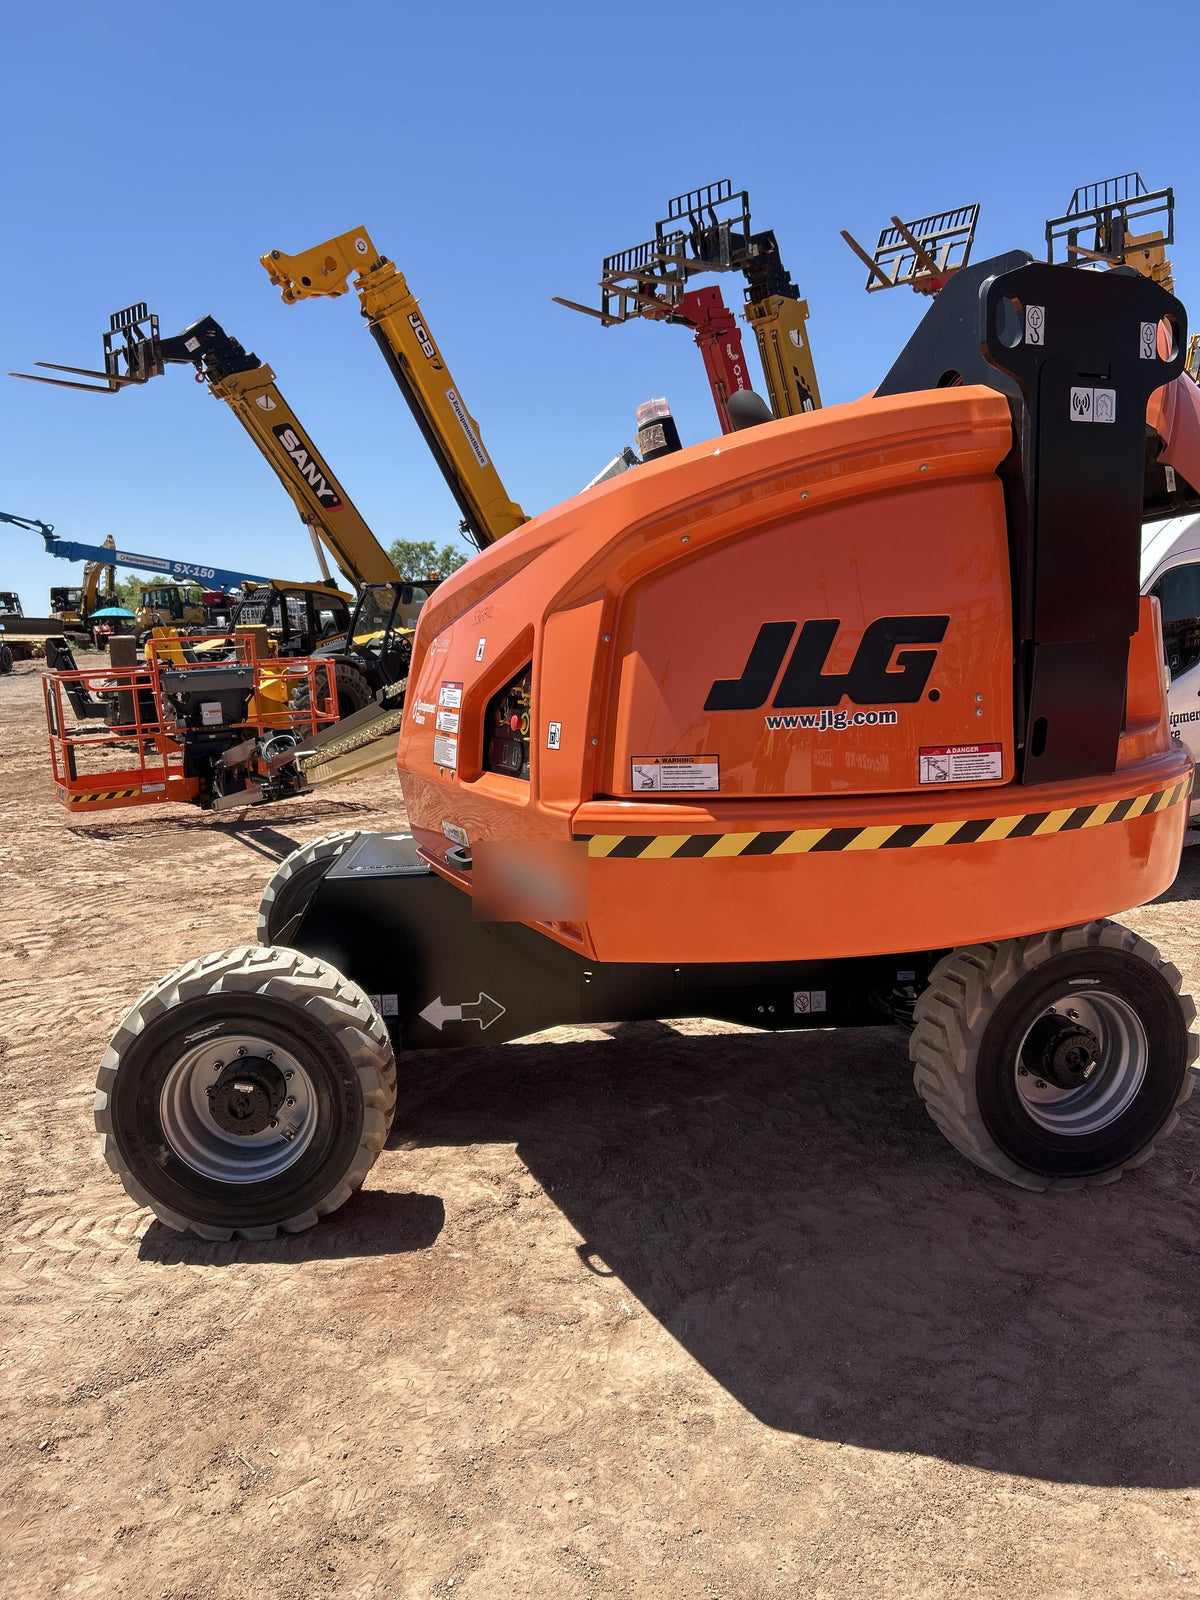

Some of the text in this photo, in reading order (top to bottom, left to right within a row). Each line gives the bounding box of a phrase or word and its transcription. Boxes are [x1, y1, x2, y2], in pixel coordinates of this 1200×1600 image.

[408, 313, 435, 358] JCB
[453, 400, 485, 463] EquipmentShare
[278, 429, 335, 498] SANY
[172, 563, 215, 579] SX-150
[703, 615, 950, 711] JLG
[765, 709, 897, 732] www.jlg.com
